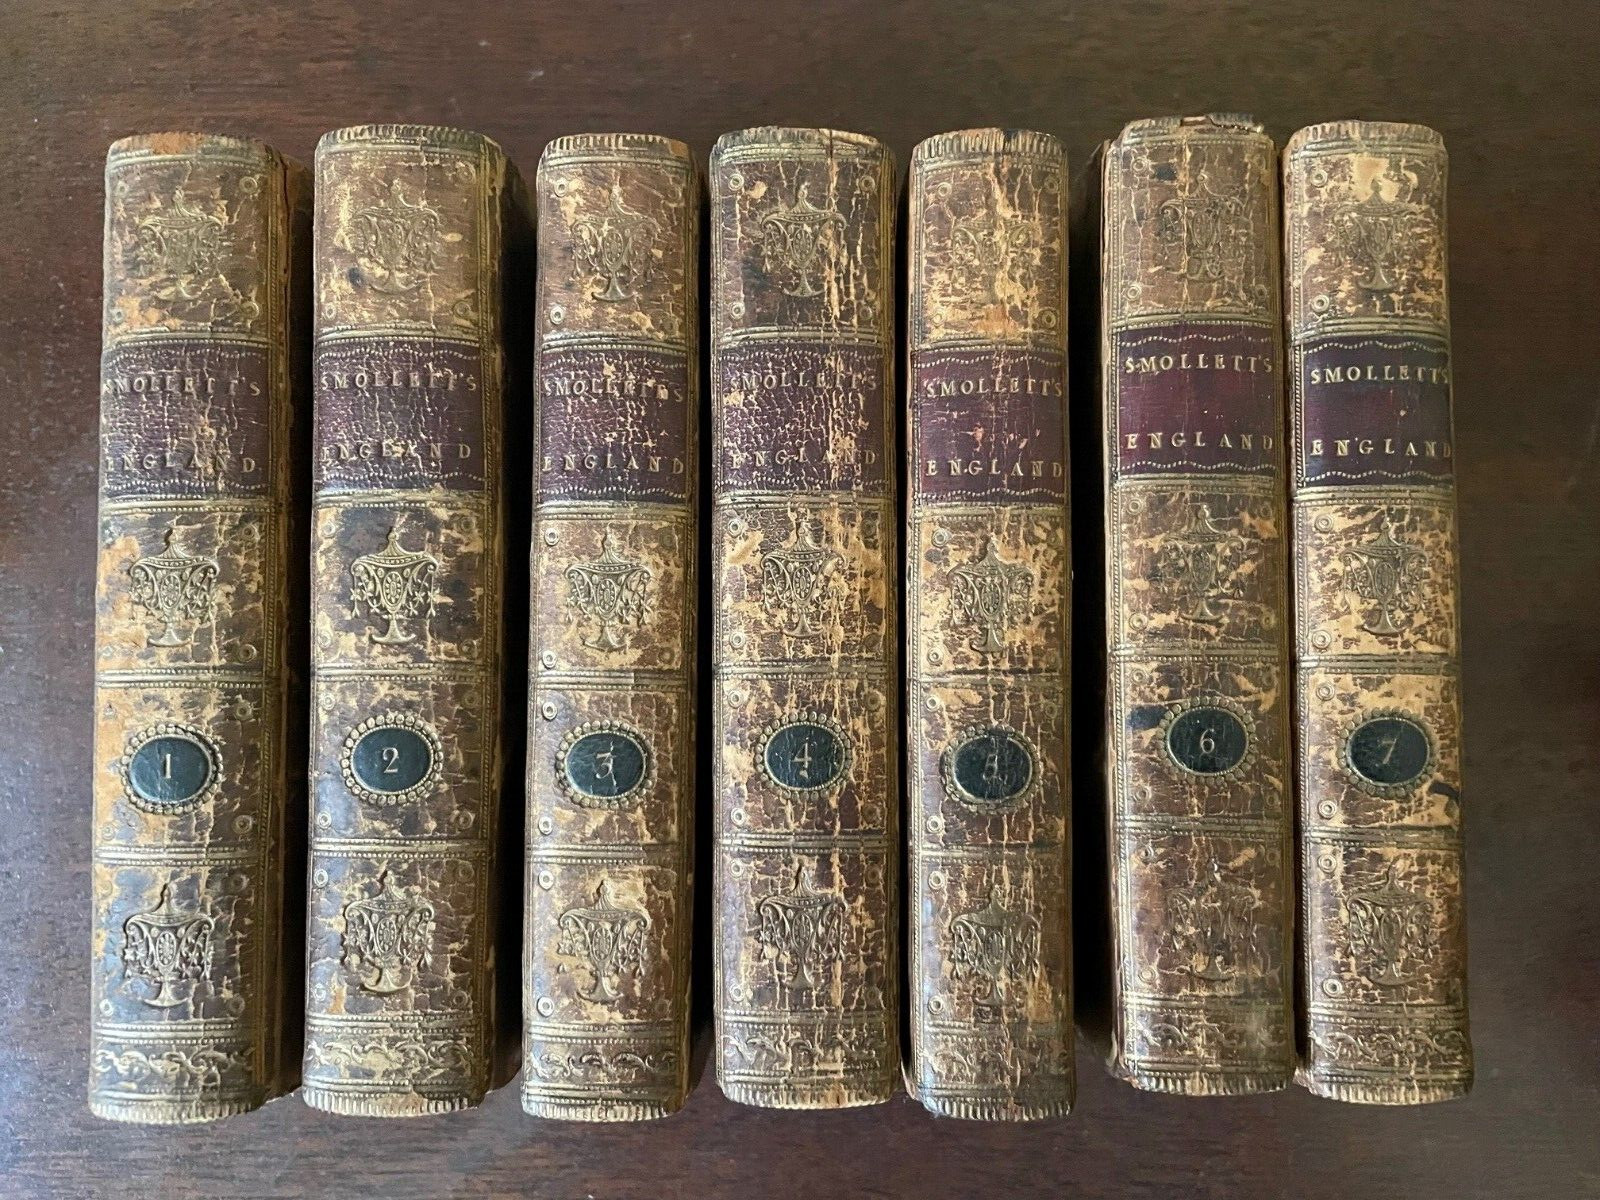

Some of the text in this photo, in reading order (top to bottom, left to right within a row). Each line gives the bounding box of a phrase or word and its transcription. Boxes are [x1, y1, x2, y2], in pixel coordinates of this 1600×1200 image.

[1125, 433, 1273, 451] ENGLAND
[1310, 438, 1451, 458] ENGLAND
[542, 454, 685, 475] ENGLAND
[925, 459, 1064, 478] ENGLAND
[792, 738, 813, 769] 4
[1198, 727, 1215, 755] 6
[1380, 738, 1397, 766] 7
[162, 753, 173, 779] 1
[381, 747, 399, 775] 2
[594, 750, 614, 780] 3
